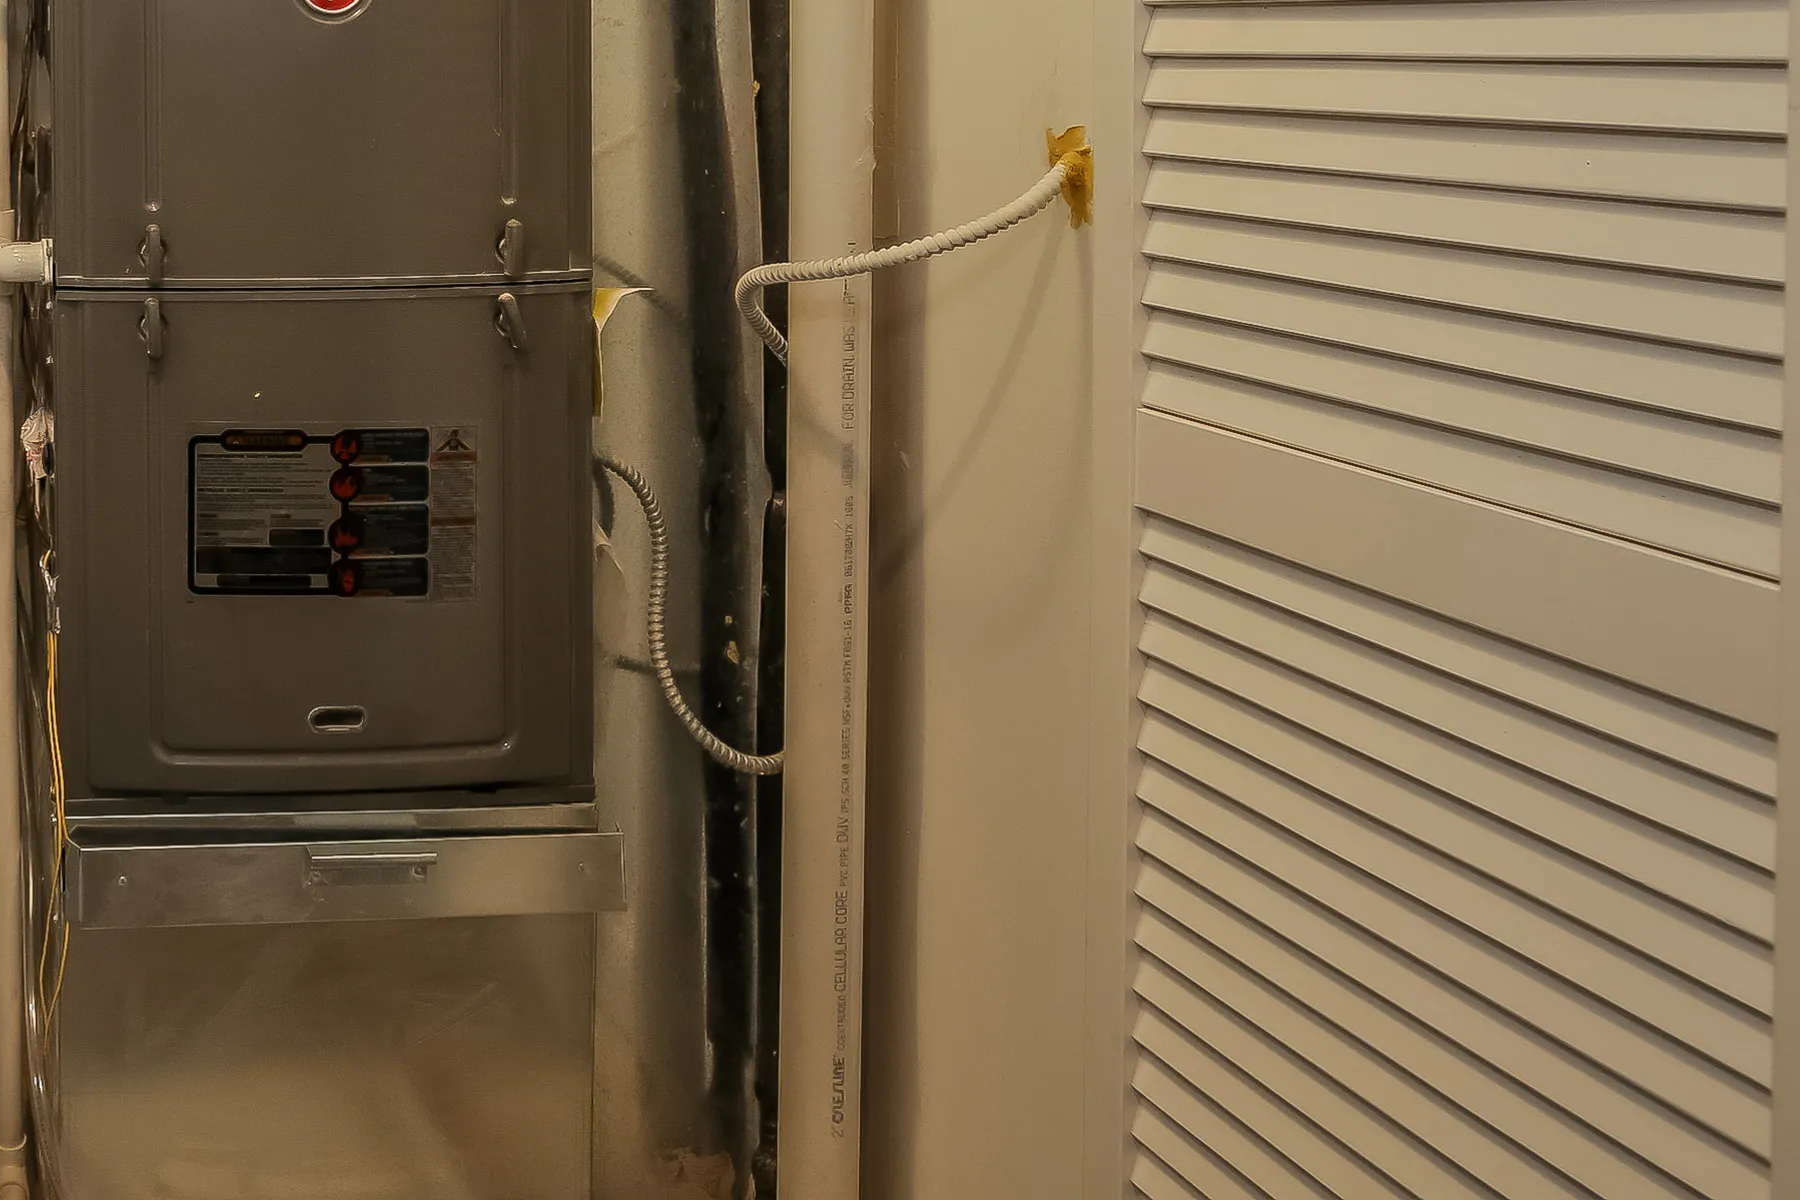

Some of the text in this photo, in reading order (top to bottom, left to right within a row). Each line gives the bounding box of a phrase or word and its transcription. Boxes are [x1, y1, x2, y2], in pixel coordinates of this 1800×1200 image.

[842, 403, 855, 430] FOR
[842, 728, 851, 760] SERIES
[840, 846, 849, 868] PIPE
[835, 891, 848, 924] CORE
